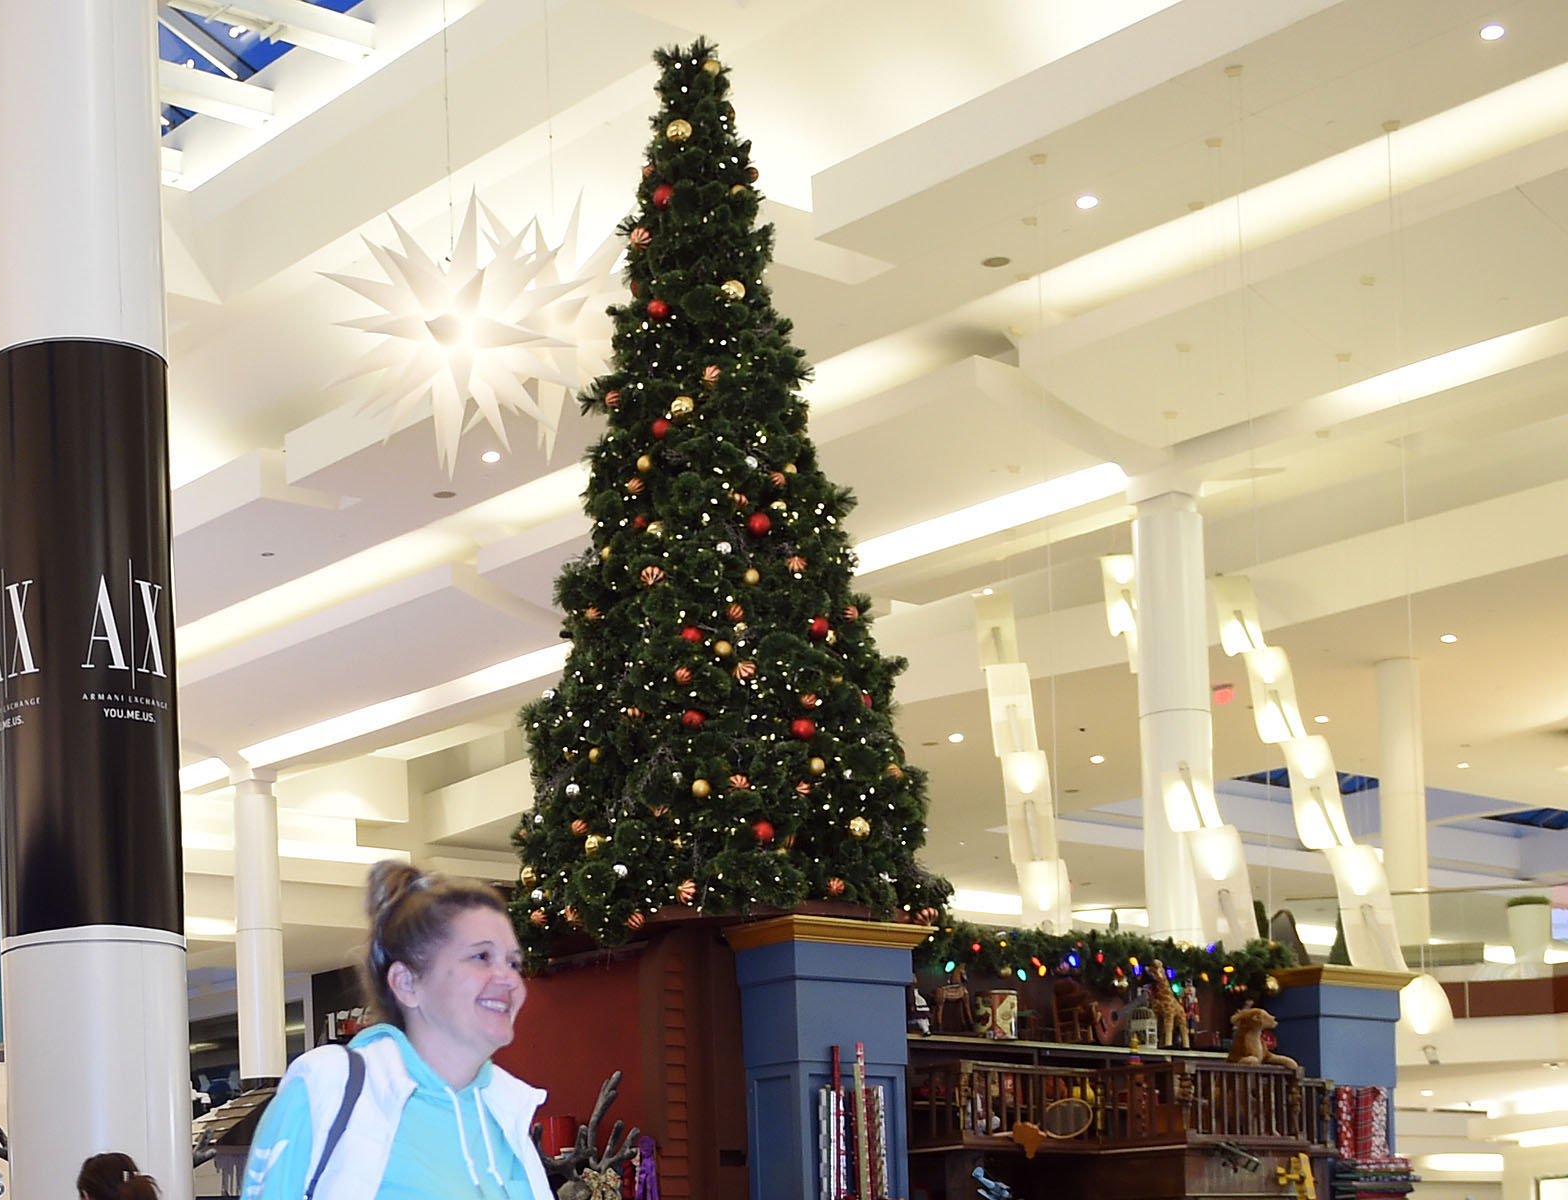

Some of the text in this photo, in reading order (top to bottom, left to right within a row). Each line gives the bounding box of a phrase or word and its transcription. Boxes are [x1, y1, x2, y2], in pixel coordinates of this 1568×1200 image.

[82, 692, 168, 710] ARMANI EXCHANGE
[103, 707, 157, 723] YOU.ME.US.
